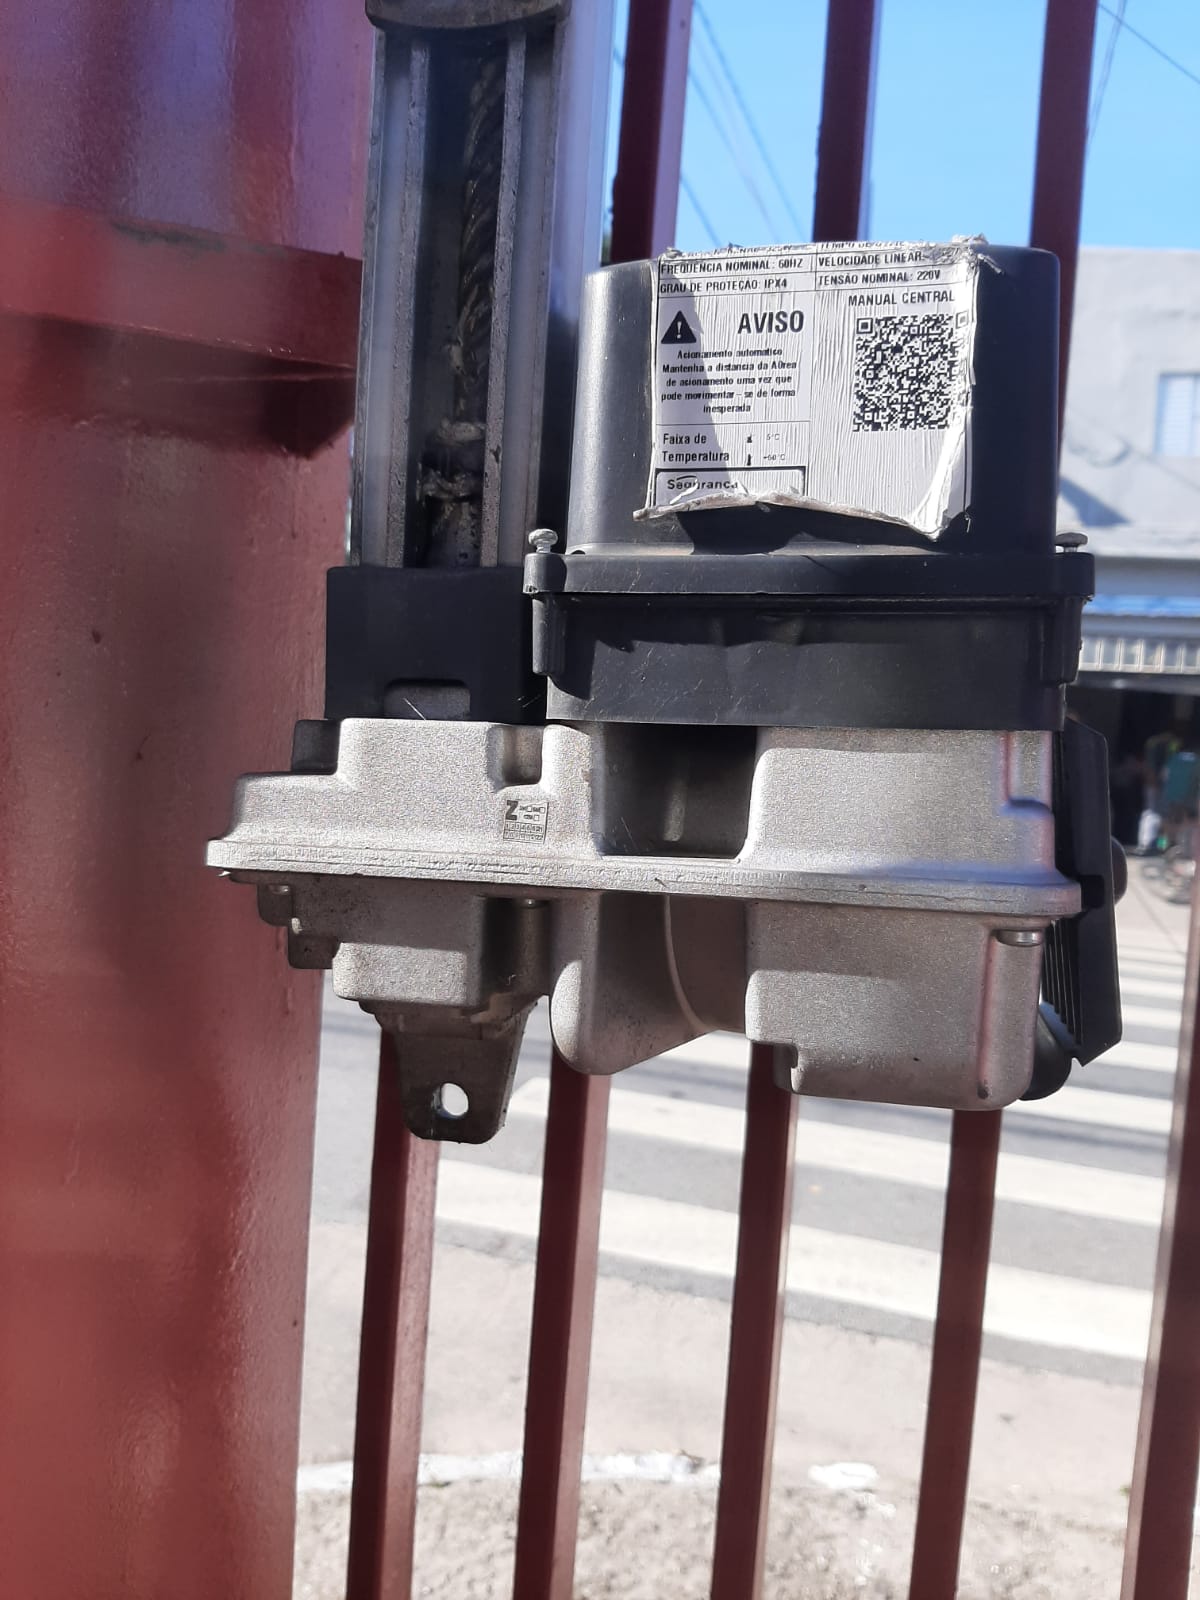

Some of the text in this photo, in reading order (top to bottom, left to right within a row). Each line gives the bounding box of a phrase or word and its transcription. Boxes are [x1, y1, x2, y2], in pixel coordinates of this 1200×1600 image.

[778, 258, 804, 268] 60HZ
[818, 255, 880, 267] VELOCIDADE
[818, 269, 941, 286] TENSÃO NOMINAL: 220V
[660, 282, 686, 294] GRAU
[690, 281, 702, 292] DE
[764, 278, 788, 289] IPX4
[848, 290, 955, 307] MANUAL CENTRAL
[737, 310, 804, 334] AVISO
[662, 363, 704, 373] Mantenha
[757, 361, 769, 370] da
[666, 375, 793, 387] de acionamento uma vez que
[661, 391, 682, 402] pode
[684, 390, 735, 400] movimentar
[756, 388, 768, 398] de
[770, 388, 796, 398] forma
[703, 404, 751, 414] inesperada
[663, 433, 707, 445] Faixa de
[662, 450, 730, 464] Temperatura
